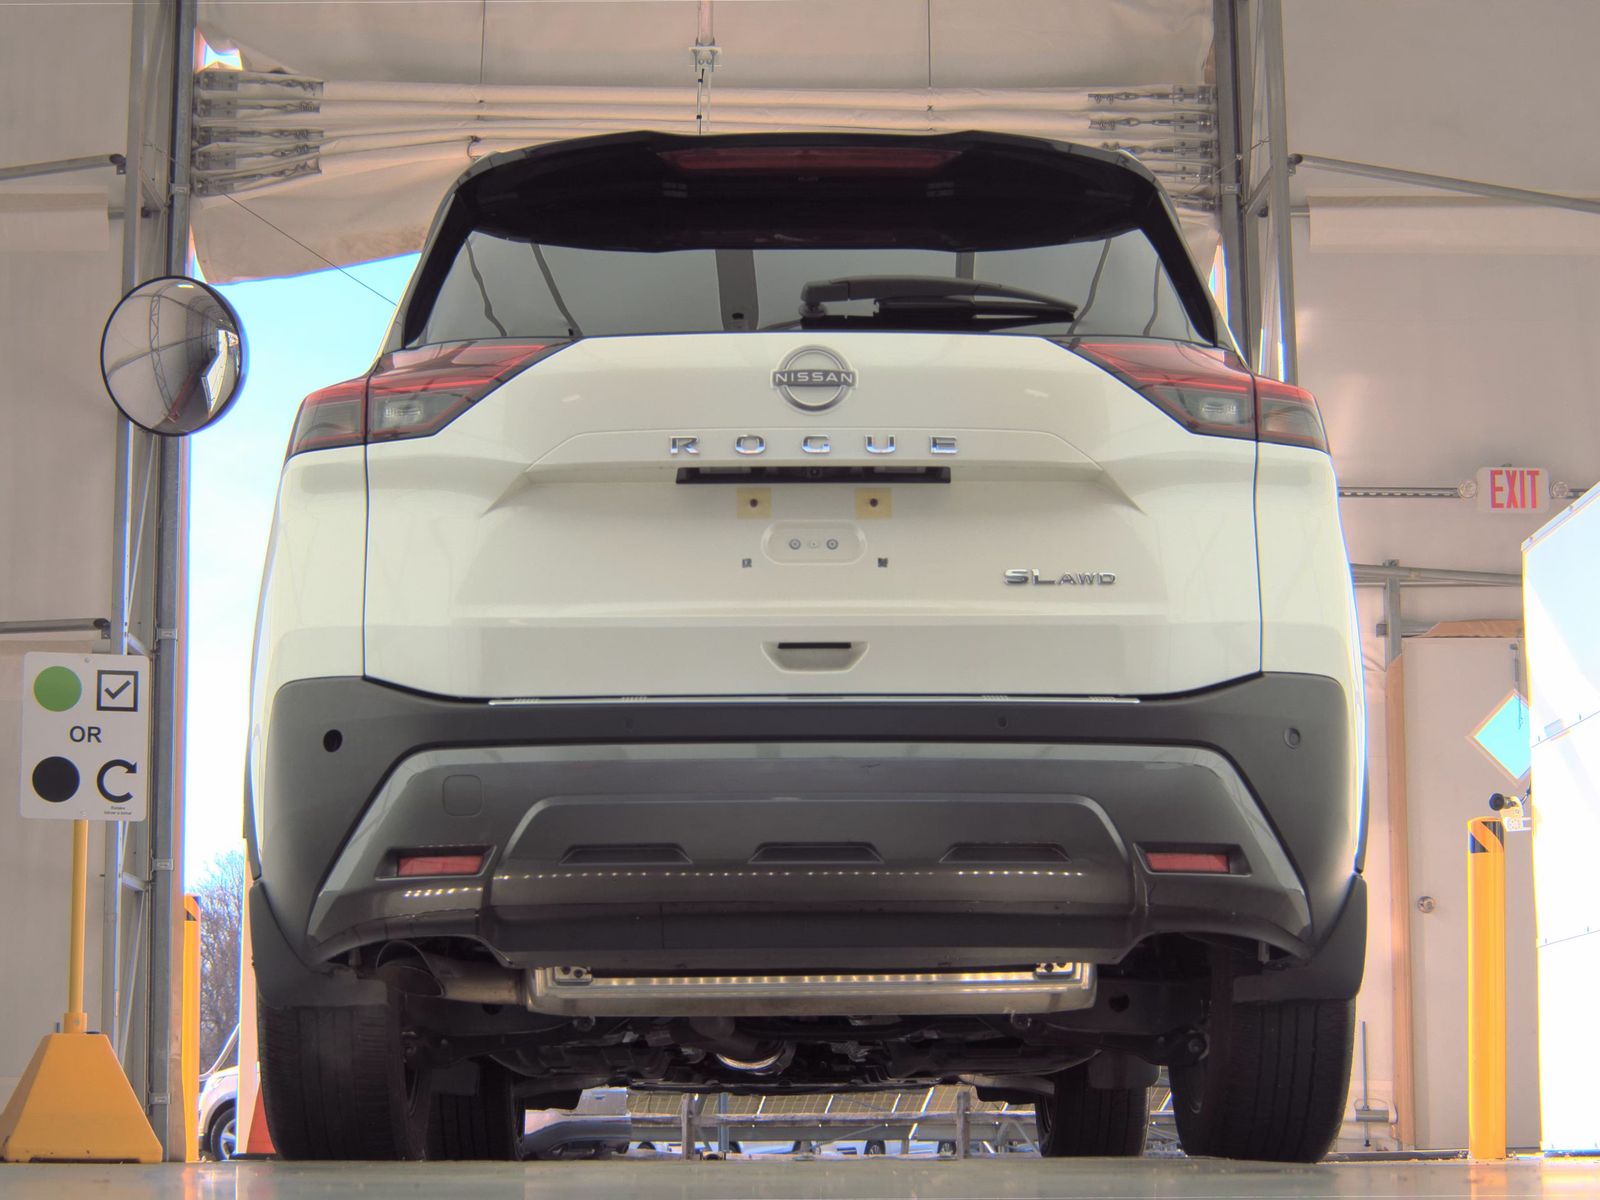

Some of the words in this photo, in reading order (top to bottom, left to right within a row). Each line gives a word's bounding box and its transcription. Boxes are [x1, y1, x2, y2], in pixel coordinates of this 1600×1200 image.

[775, 371, 854, 383] NISSAN
[669, 434, 960, 455] ROGUE
[1490, 469, 1540, 509] EXIT
[69, 725, 102, 743] OR
